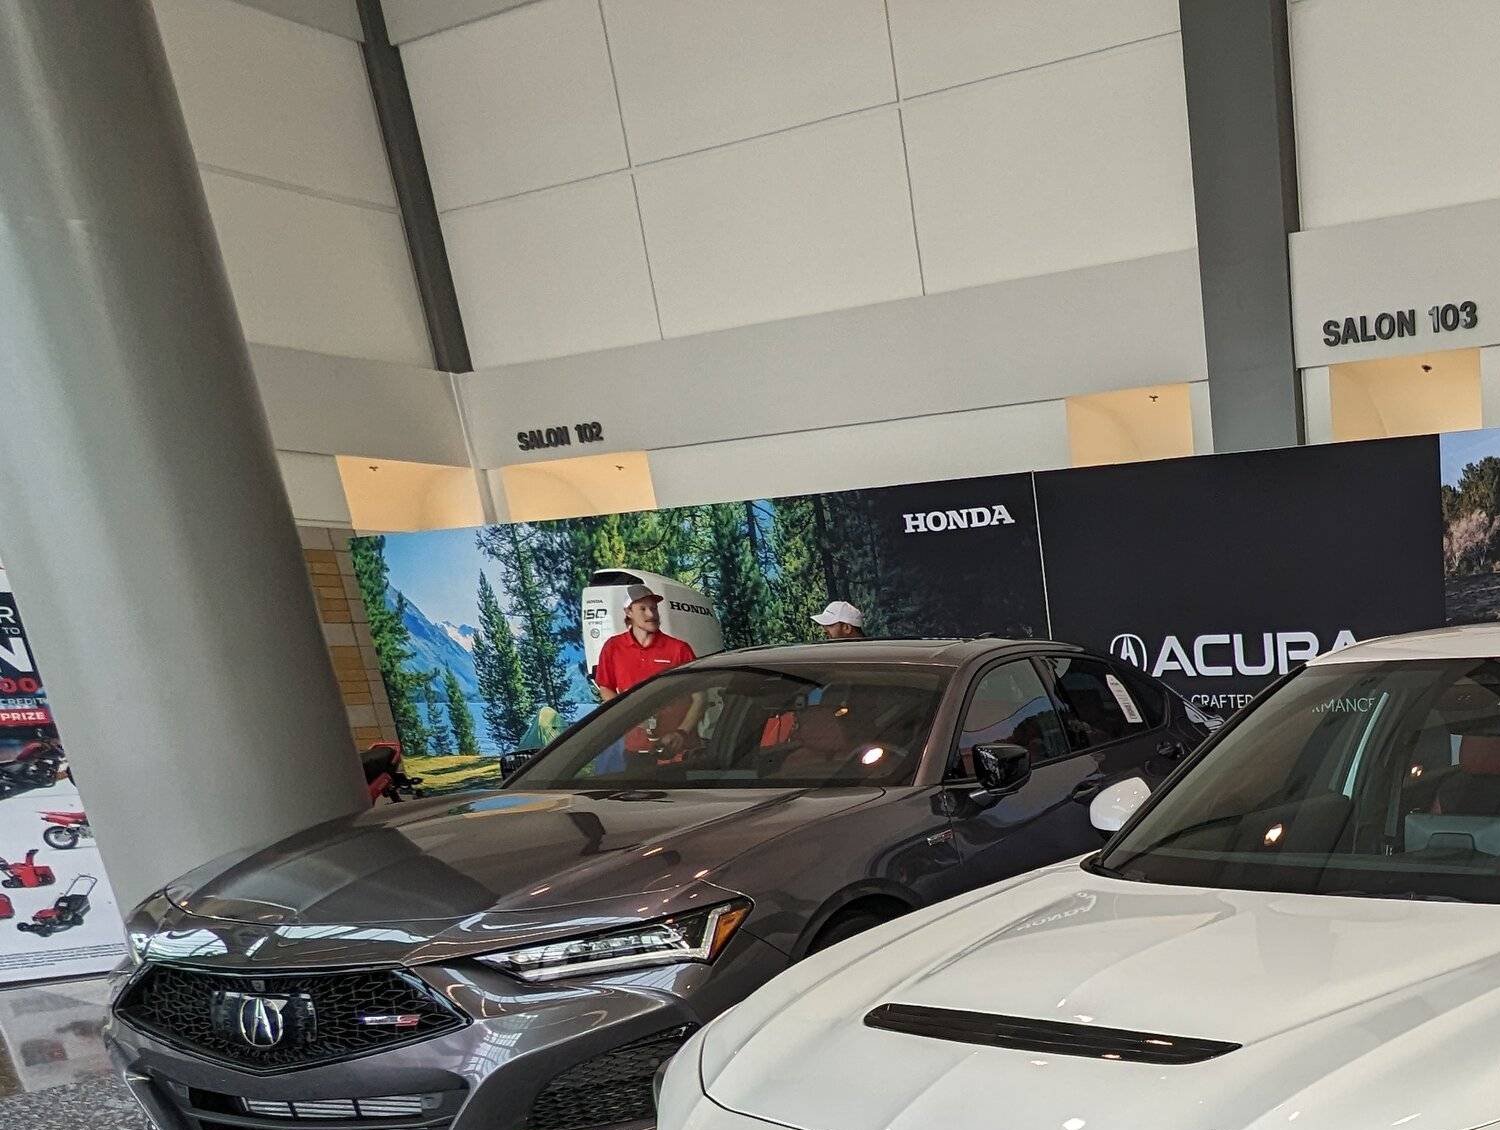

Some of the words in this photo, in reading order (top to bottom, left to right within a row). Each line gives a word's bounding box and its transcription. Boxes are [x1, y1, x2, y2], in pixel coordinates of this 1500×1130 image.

[1322, 309, 1416, 347] SALON
[1428, 301, 1478, 333] 103
[517, 426, 571, 451] SALON
[574, 421, 604, 443] 102
[902, 504, 1016, 533] HONDA
[669, 601, 713, 617] HONDA
[1191, 694, 1254, 709] CRAFTED
[0, 711, 47, 721] PRIZE
